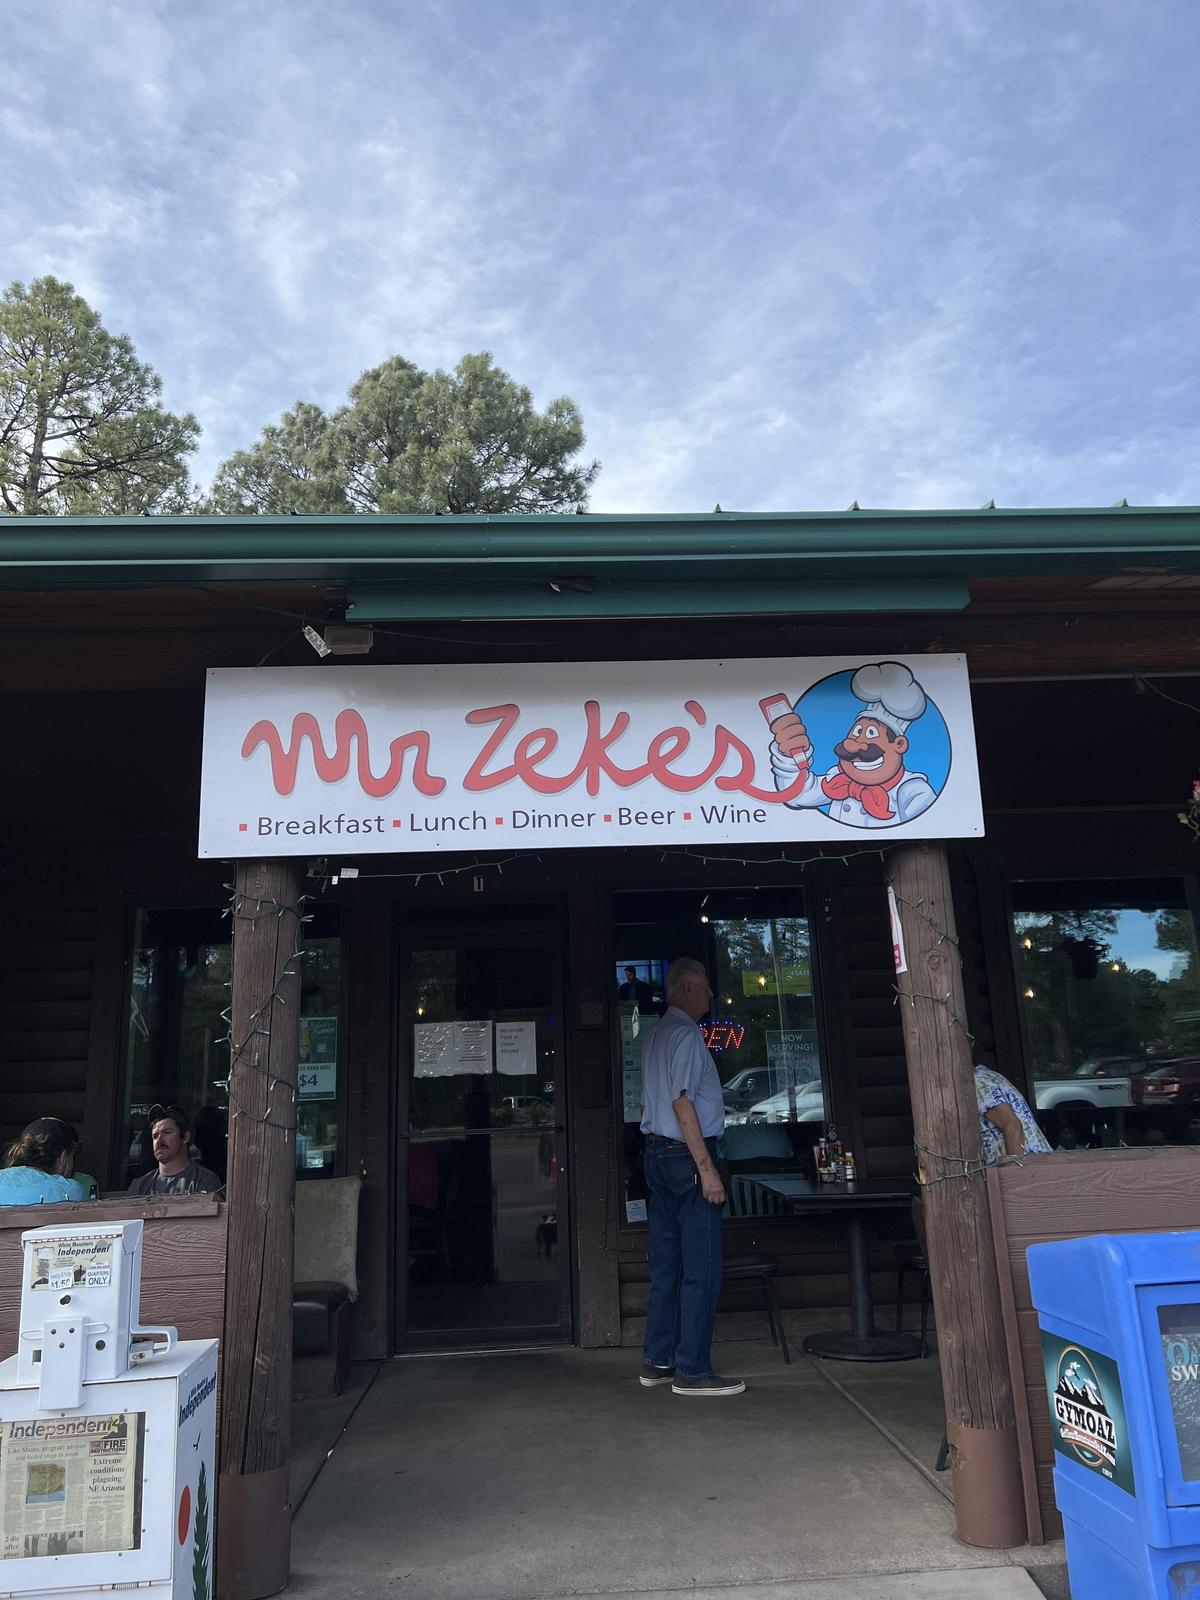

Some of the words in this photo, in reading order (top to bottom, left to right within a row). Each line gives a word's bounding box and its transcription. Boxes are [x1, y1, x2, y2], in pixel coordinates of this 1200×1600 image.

[463, 699, 805, 803] Zeke's
[258, 813, 385, 836] Breakfast
[410, 810, 487, 832] Lunch
[512, 808, 596, 829] Dinner
[618, 806, 676, 826] Beer
[700, 804, 767, 824] Wine
[699, 1026, 745, 1049] EN
[782, 1033, 803, 1042] NOW
[772, 1042, 814, 1052] SERVING!
[298, 1074, 318, 1088] $4
[57, 1245, 110, 1257] Independent
[51, 1278, 71, 1289] $1.50
[88, 1277, 107, 1286] ONLY
[178, 1371, 217, 1428] Independent
[1055, 1397, 1115, 1446] GYMOAZ
[9, 1415, 114, 1440] Independent
[104, 1439, 126, 1448] FIRE
[93, 1457, 122, 1465] Extreme
[90, 1466, 125, 1475] conditions
[92, 1475, 122, 1485] plaguing
[101, 1484, 125, 1492] Arizona
